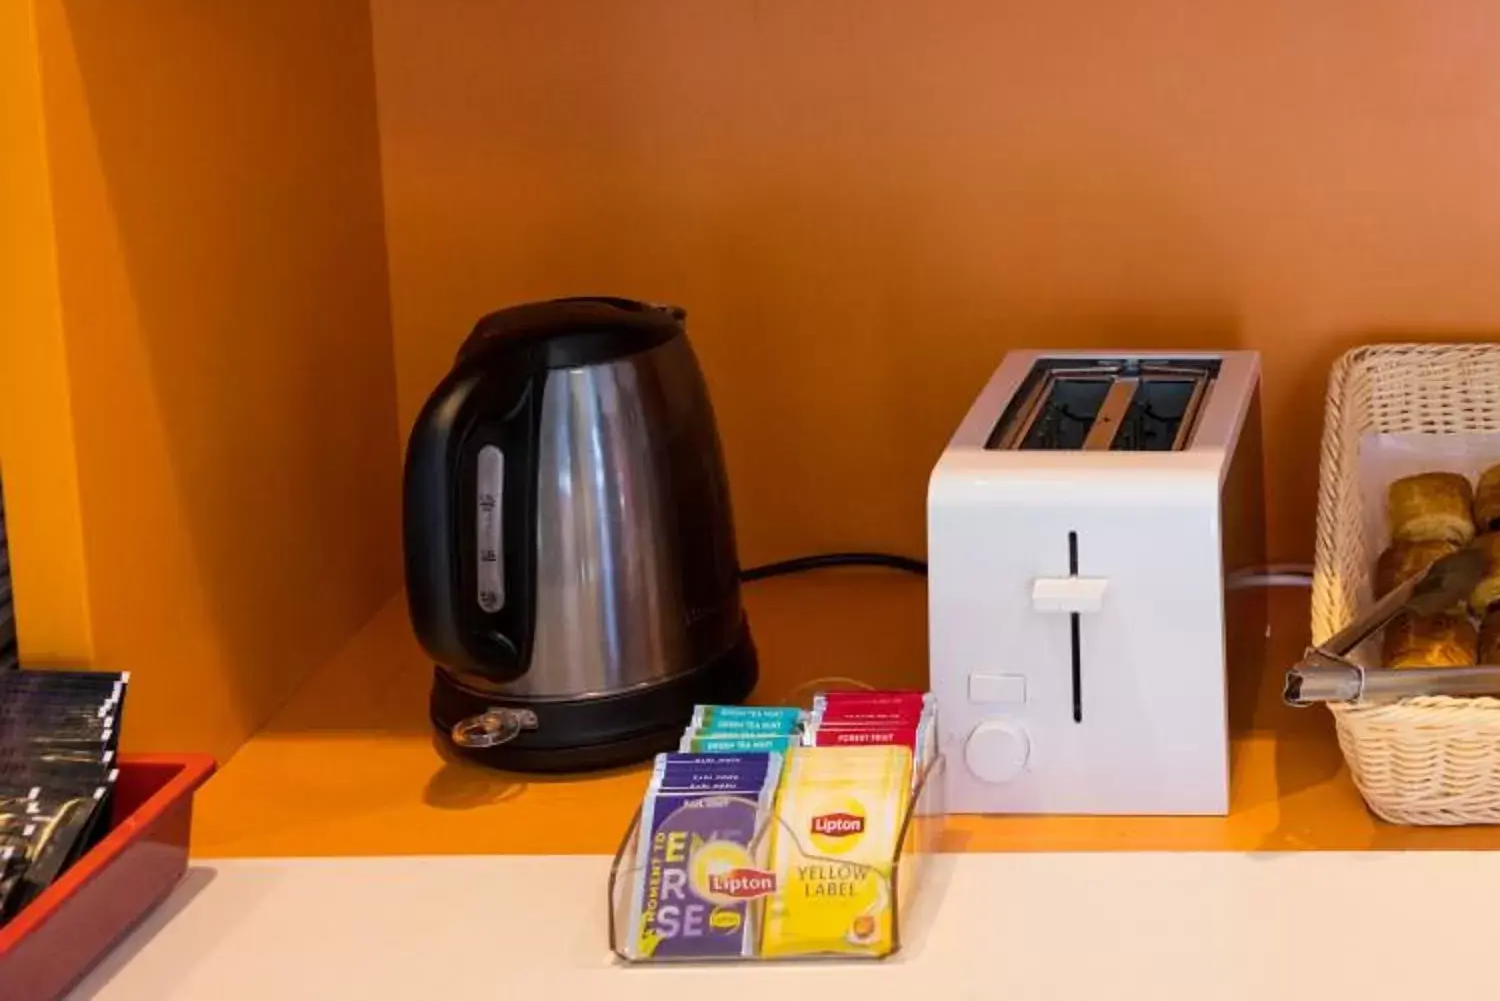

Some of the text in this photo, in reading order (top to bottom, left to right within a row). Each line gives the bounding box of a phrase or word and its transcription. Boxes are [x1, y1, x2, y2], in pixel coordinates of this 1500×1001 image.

[815, 818, 861, 833] Lipton
[798, 864, 868, 880] YELLOW
[711, 876, 772, 893] Lipton
[805, 883, 856, 897] LABEL
